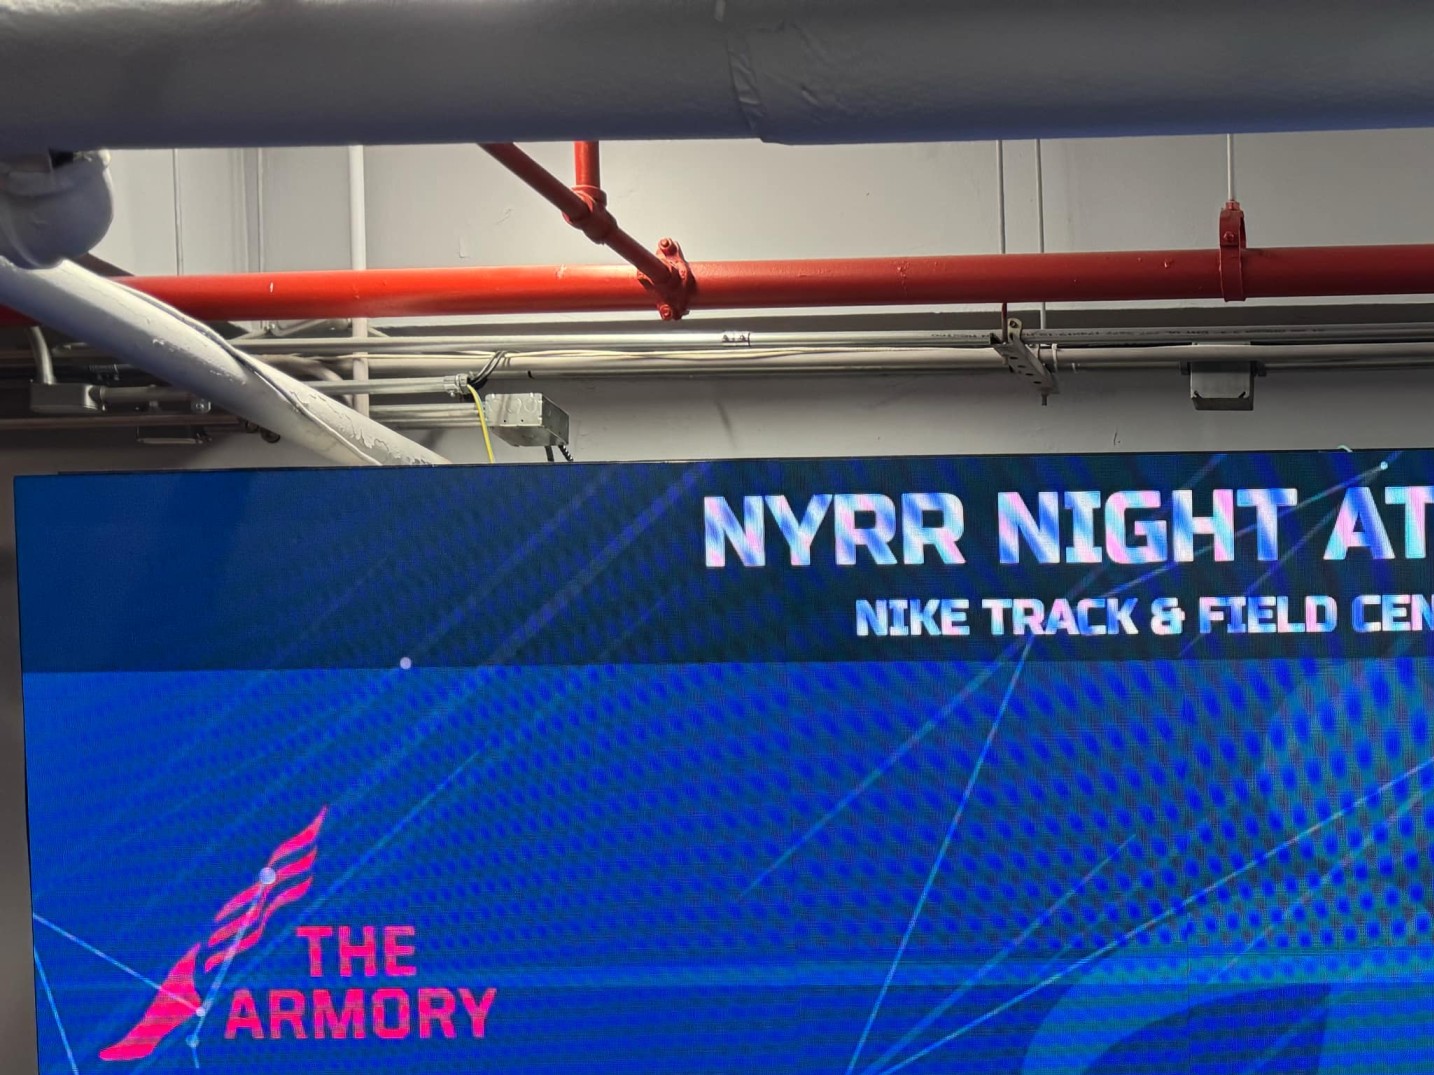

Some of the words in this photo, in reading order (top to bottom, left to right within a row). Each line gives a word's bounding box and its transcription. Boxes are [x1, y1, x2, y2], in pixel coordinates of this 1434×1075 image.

[704, 493, 965, 568] NYRR
[999, 488, 1298, 564] NIGHT
[856, 598, 970, 637] NIKE
[981, 597, 1138, 636] TRACK
[1150, 597, 1186, 635] &
[1199, 594, 1338, 635] FIELD
[296, 925, 417, 977] THE
[223, 988, 498, 1040] ARMORY
